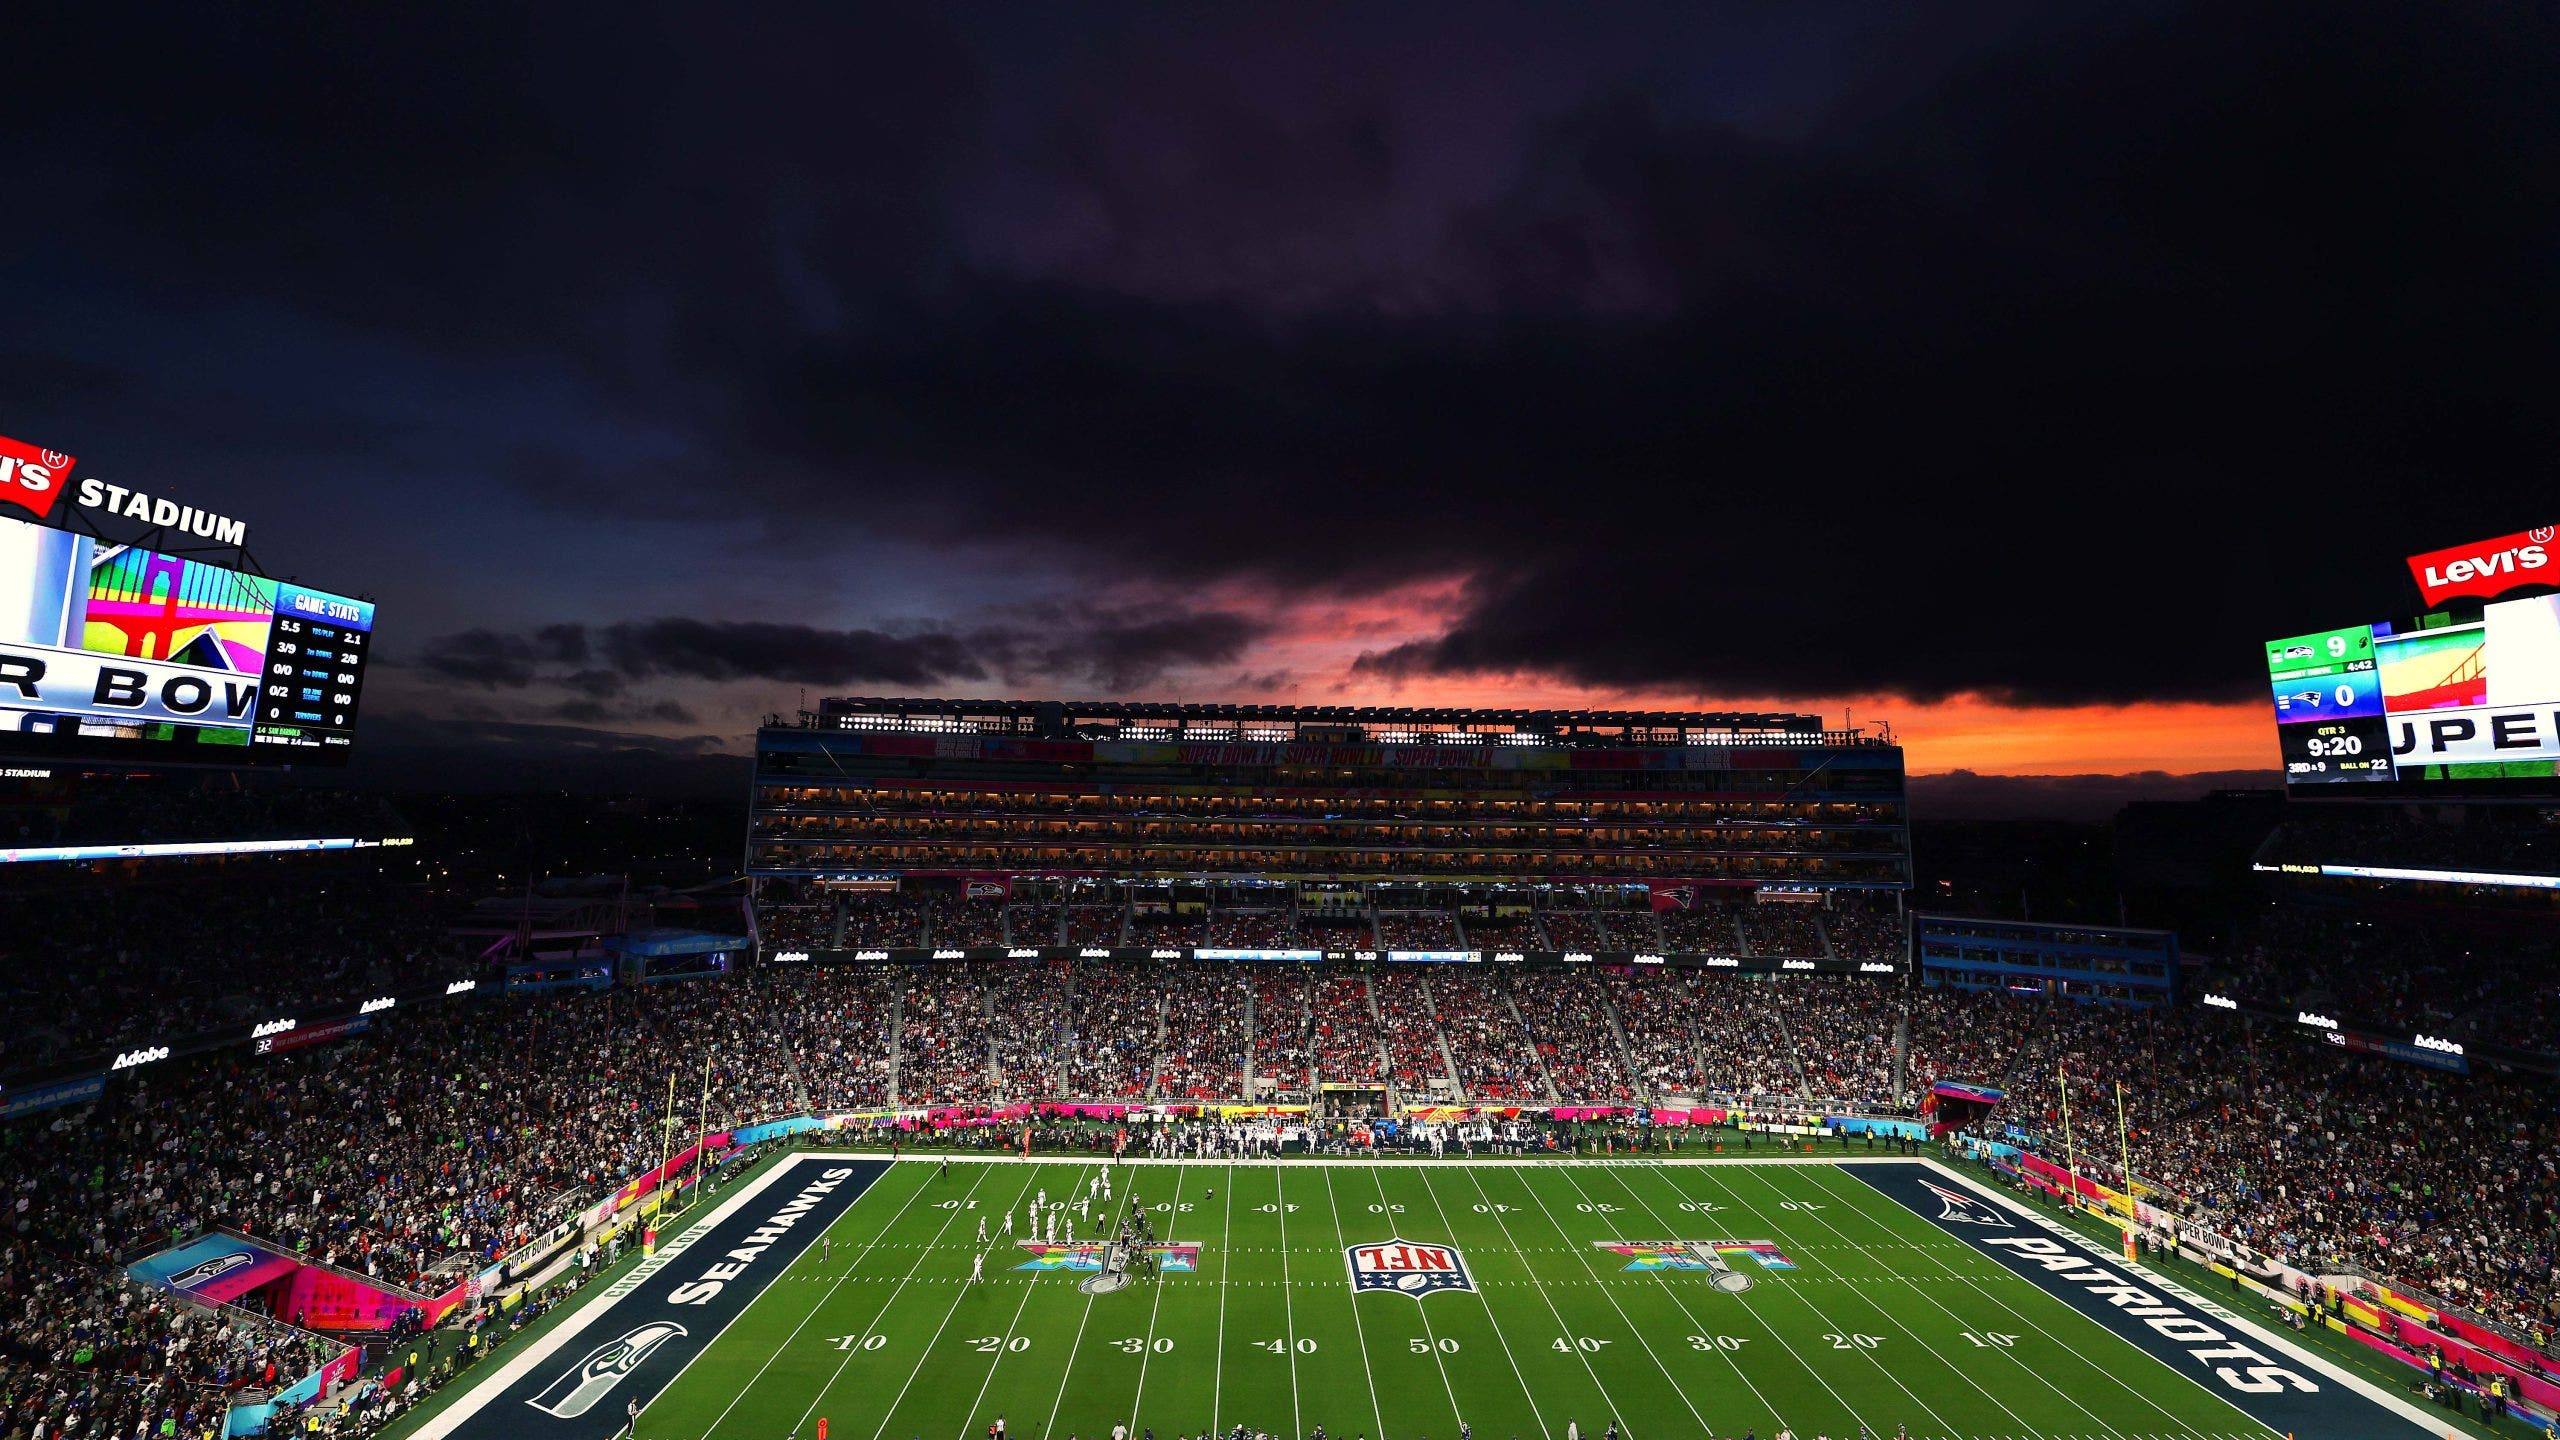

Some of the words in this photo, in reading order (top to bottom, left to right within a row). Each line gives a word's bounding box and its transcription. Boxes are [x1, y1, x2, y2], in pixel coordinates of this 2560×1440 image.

[78, 478, 246, 547] STADIUM
[295, 594, 325, 615] GAME
[328, 601, 360, 622] STATS
[280, 620, 301, 634] 5.5
[344, 632, 361, 645] 2.1
[276, 641, 297, 654] 3/9
[2327, 636, 2347, 658] 9
[341, 653, 359, 665] 2/8
[273, 663, 292, 676] 0/0
[2347, 660, 2373, 671] 4:42
[337, 673, 355, 684] 0/0
[269, 685, 289, 697] 0/2
[2335, 684, 2355, 707] 0
[334, 694, 351, 705] 0/0
[270, 708, 280, 718] 0
[335, 715, 344, 725] 0
[256, 726, 267, 734] 14
[2318, 727, 2336, 736] QTR
[2339, 726, 2346, 734] 3
[2308, 735, 2362, 757] 9:20
[2317, 761, 2326, 772] 9
[2340, 762, 2359, 770] BALL
[2371, 758, 2388, 770] 22
[4, 769, 51, 778] STADIUM
[774, 952, 809, 962] Adobe
[855, 951, 888, 961] Adobe
[932, 950, 965, 959] Adobe
[1007, 948, 1039, 958] Adobe
[1079, 948, 1111, 958] Adobe
[1150, 950, 1182, 961] Adobe
[1354, 951, 1377, 961] 9:20
[1494, 952, 1525, 962] Adobe
[1563, 952, 1593, 962] Adobe
[1633, 953, 1665, 964] Adobe
[1707, 956, 1739, 967] Adobe
[1782, 959, 1816, 970] Adobe
[1859, 962, 1894, 973] Adobe
[446, 979, 476, 995] Adobe
[359, 997, 396, 1014] Adobe
[2203, 993, 2237, 1010] Adobe
[2298, 1011, 2338, 1030] Adobe
[251, 1018, 296, 1038] Adobe
[256, 1039, 272, 1054] 32
[2414, 1033, 2464, 1055] Adobe
[112, 1046, 170, 1070] Adobe
[2010, 1125, 2019, 1134] 12
[942, 1200, 979, 1211] 10
[1156, 1202, 1195, 1212] 30
[1263, 1203, 1300, 1213] 40
[1368, 1203, 1406, 1213] 50
[1472, 1203, 1512, 1213] 40
[1576, 1203, 1618, 1213] 30
[1679, 1202, 1721, 1212] 20
[1779, 1201, 1816, 1212] 10
[531, 1233, 552, 1257] BOWL
[553, 1216, 580, 1244] LX
[667, 1167, 854, 1305] SEAHAWKS
[2202, 1229, 2227, 1250] BOWL
[604, 1253, 675, 1298] CHOOSE
[673, 1223, 713, 1255] LOVE
[1359, 1245, 1452, 1271] NFL
[2048, 1225, 2113, 1254] TAKES
[2111, 1259, 2155, 1279] ALL
[2159, 1283, 2198, 1298] OF
[2196, 1302, 2237, 1319] US
[1980, 1237, 2320, 1393] PATRIOTS
[834, 1335, 887, 1352] 10
[974, 1336, 1031, 1353] 20
[1122, 1337, 1174, 1354] 30
[1551, 1336, 1602, 1353] 40
[1686, 1335, 1741, 1352] 30
[1822, 1333, 1874, 1350] 20
[1959, 1331, 2013, 1348] 10
[1265, 1337, 1318, 1355] 40
[1409, 1337, 1460, 1355] 50
